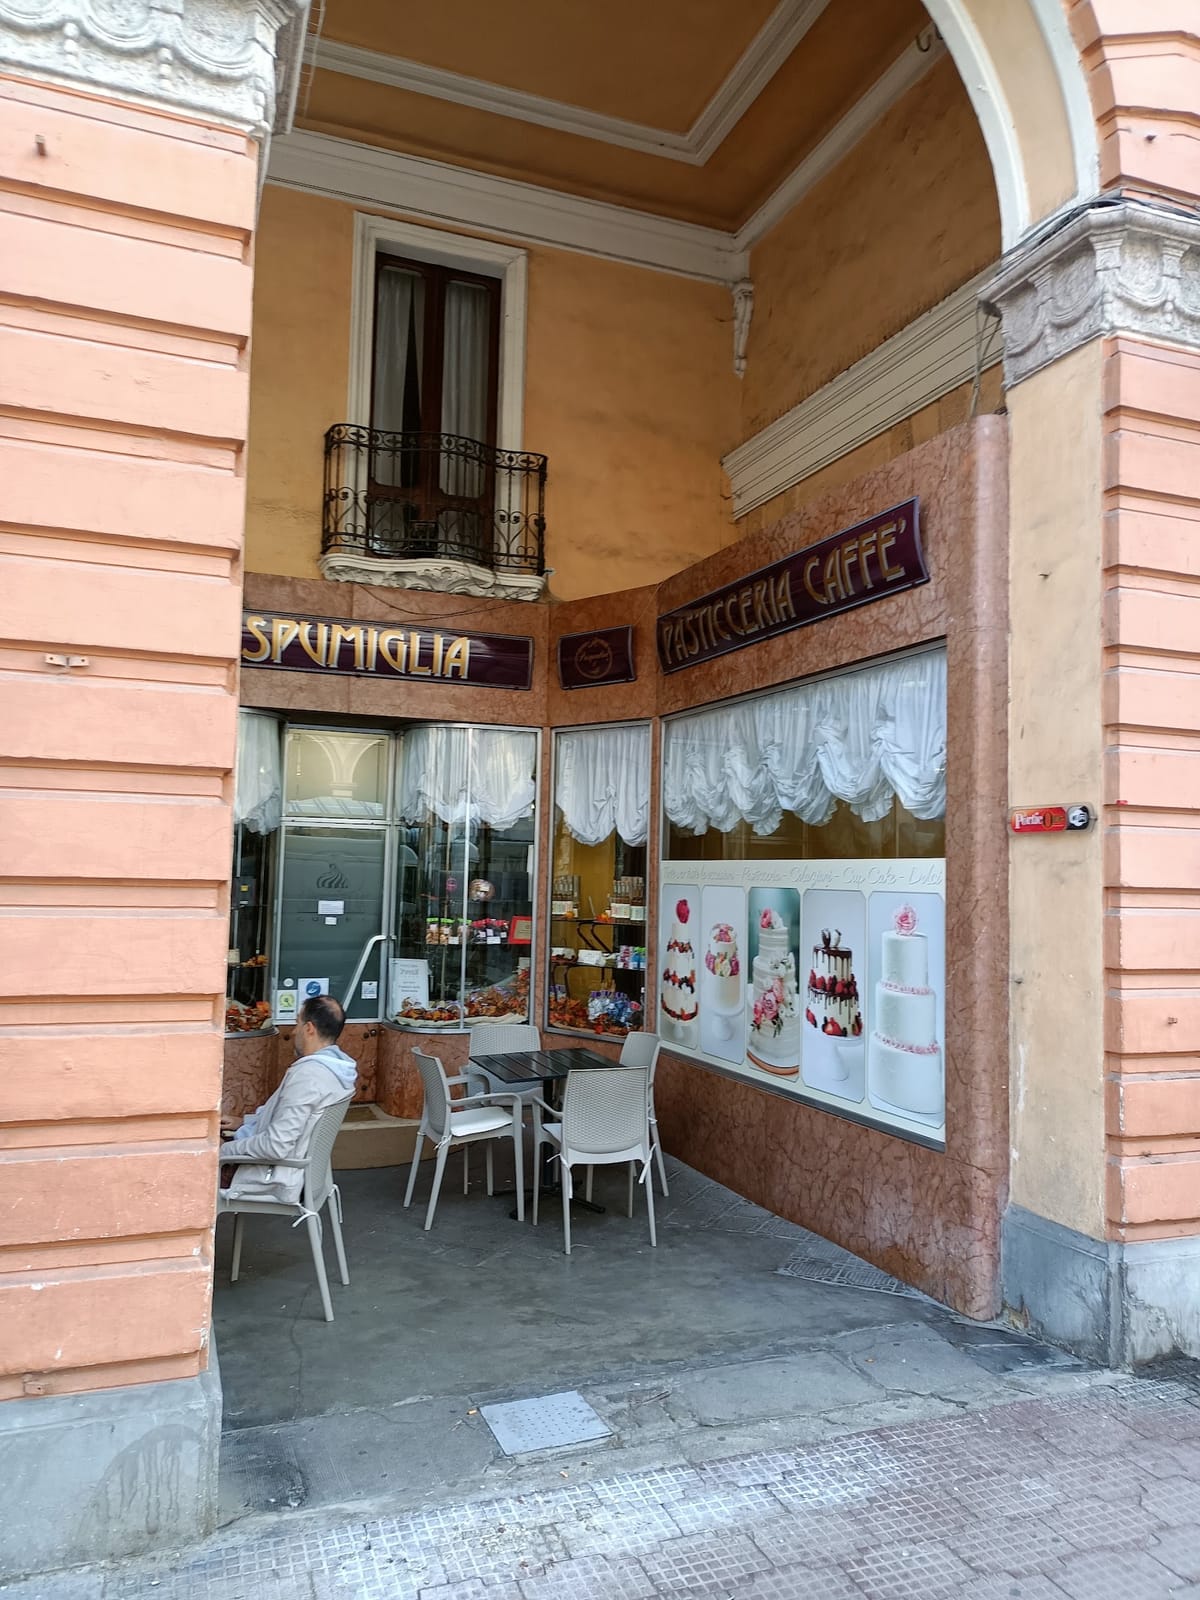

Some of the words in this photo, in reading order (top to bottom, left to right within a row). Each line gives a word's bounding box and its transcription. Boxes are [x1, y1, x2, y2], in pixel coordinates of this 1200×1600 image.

[241, 615, 471, 680] SPUMIGLIA
[662, 570, 797, 664] PASTICCERIA
[908, 864, 943, 886] Dolci
